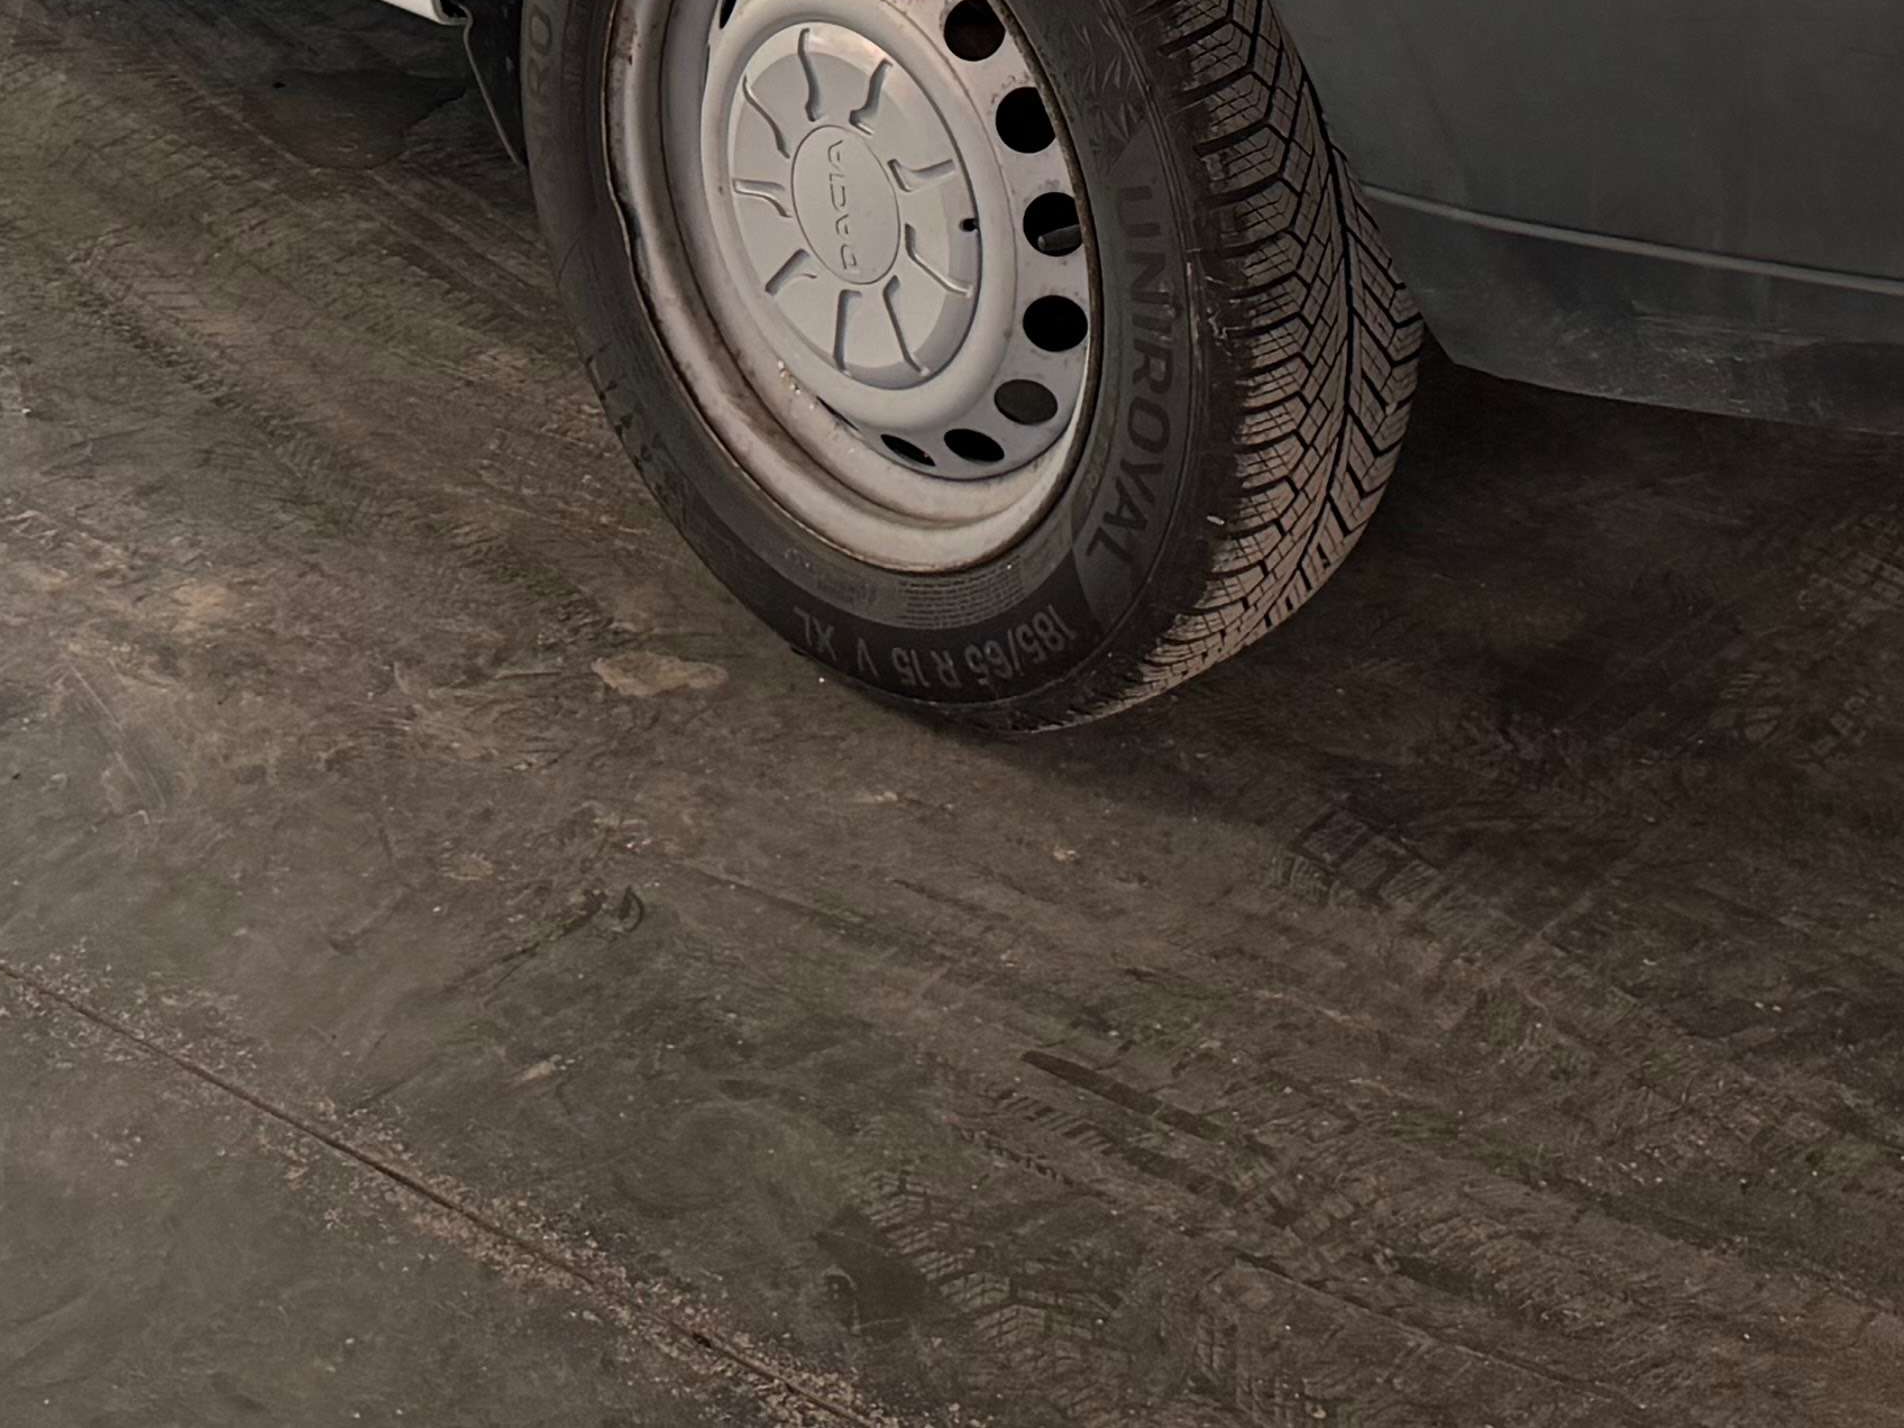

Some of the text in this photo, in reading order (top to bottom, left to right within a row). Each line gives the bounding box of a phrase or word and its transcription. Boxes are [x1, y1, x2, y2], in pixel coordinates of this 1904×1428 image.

[827, 138, 861, 276] DACIA
[1088, 185, 1174, 564] UNIROYAL
[793, 604, 839, 662] XL
[855, 636, 880, 679] V
[964, 604, 1077, 686] 185/65
